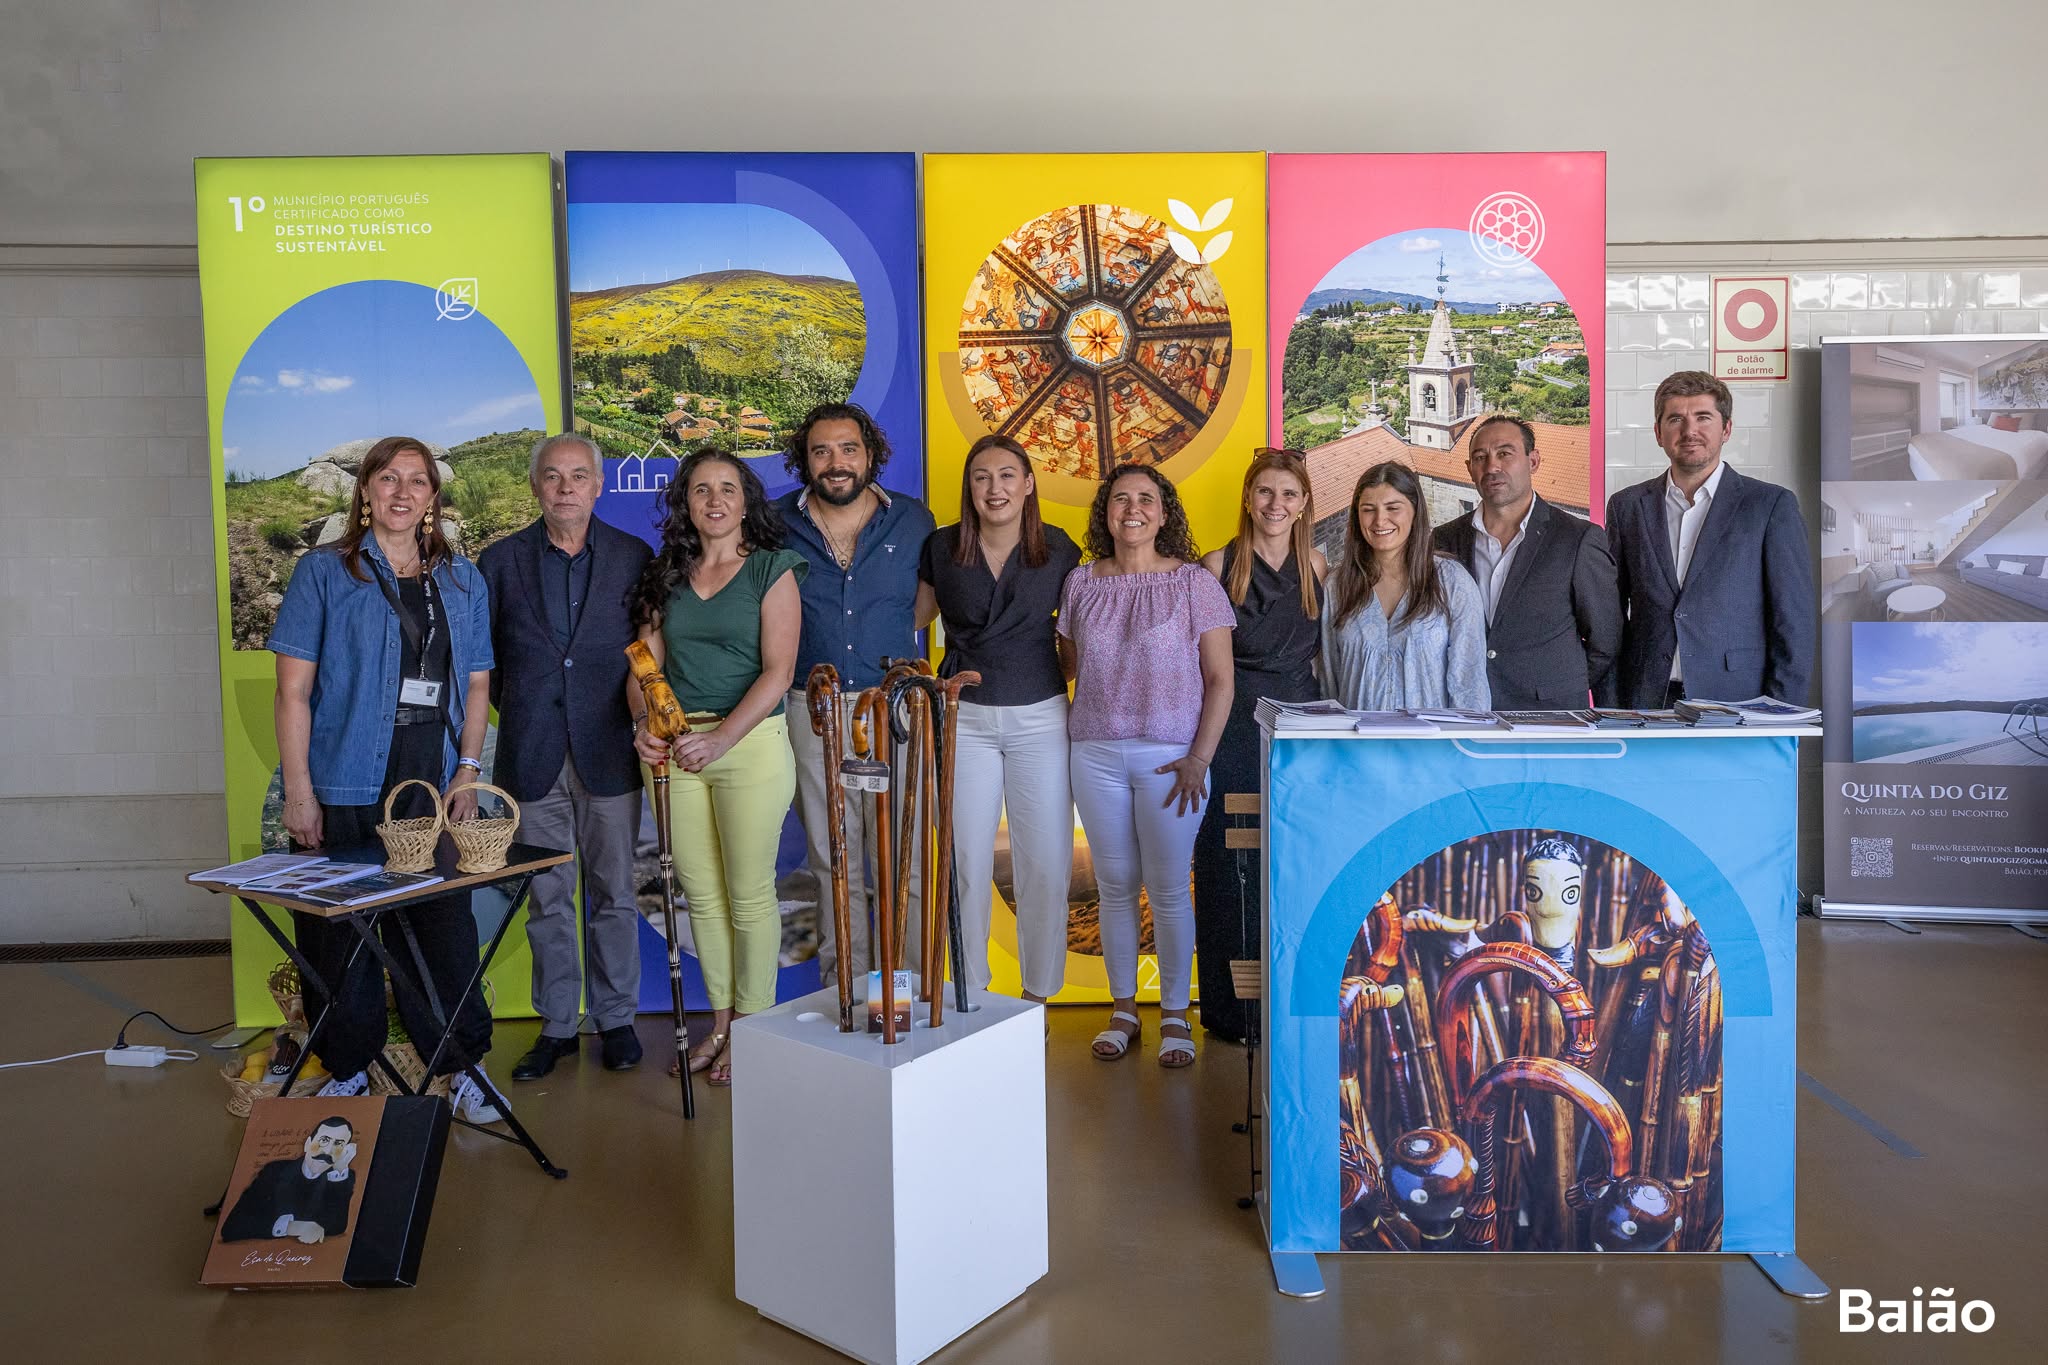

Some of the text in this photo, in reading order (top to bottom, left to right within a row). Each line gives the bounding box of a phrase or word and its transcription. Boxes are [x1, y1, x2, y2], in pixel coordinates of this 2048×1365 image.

[273, 192, 429, 206] MUNICÍPIO PORTUGUÊS
[274, 208, 405, 220] CERTIFICADO COMO
[275, 221, 432, 236] DESTINO TURÍSTICO
[275, 238, 387, 253] SUSTENTÁVEL
[1737, 355, 1765, 363] Botão
[1727, 366, 1774, 375] de alarme
[1843, 807, 1851, 815] A
[1929, 809, 1948, 817] SEU
[1952, 810, 2009, 818] ENCONTRO
